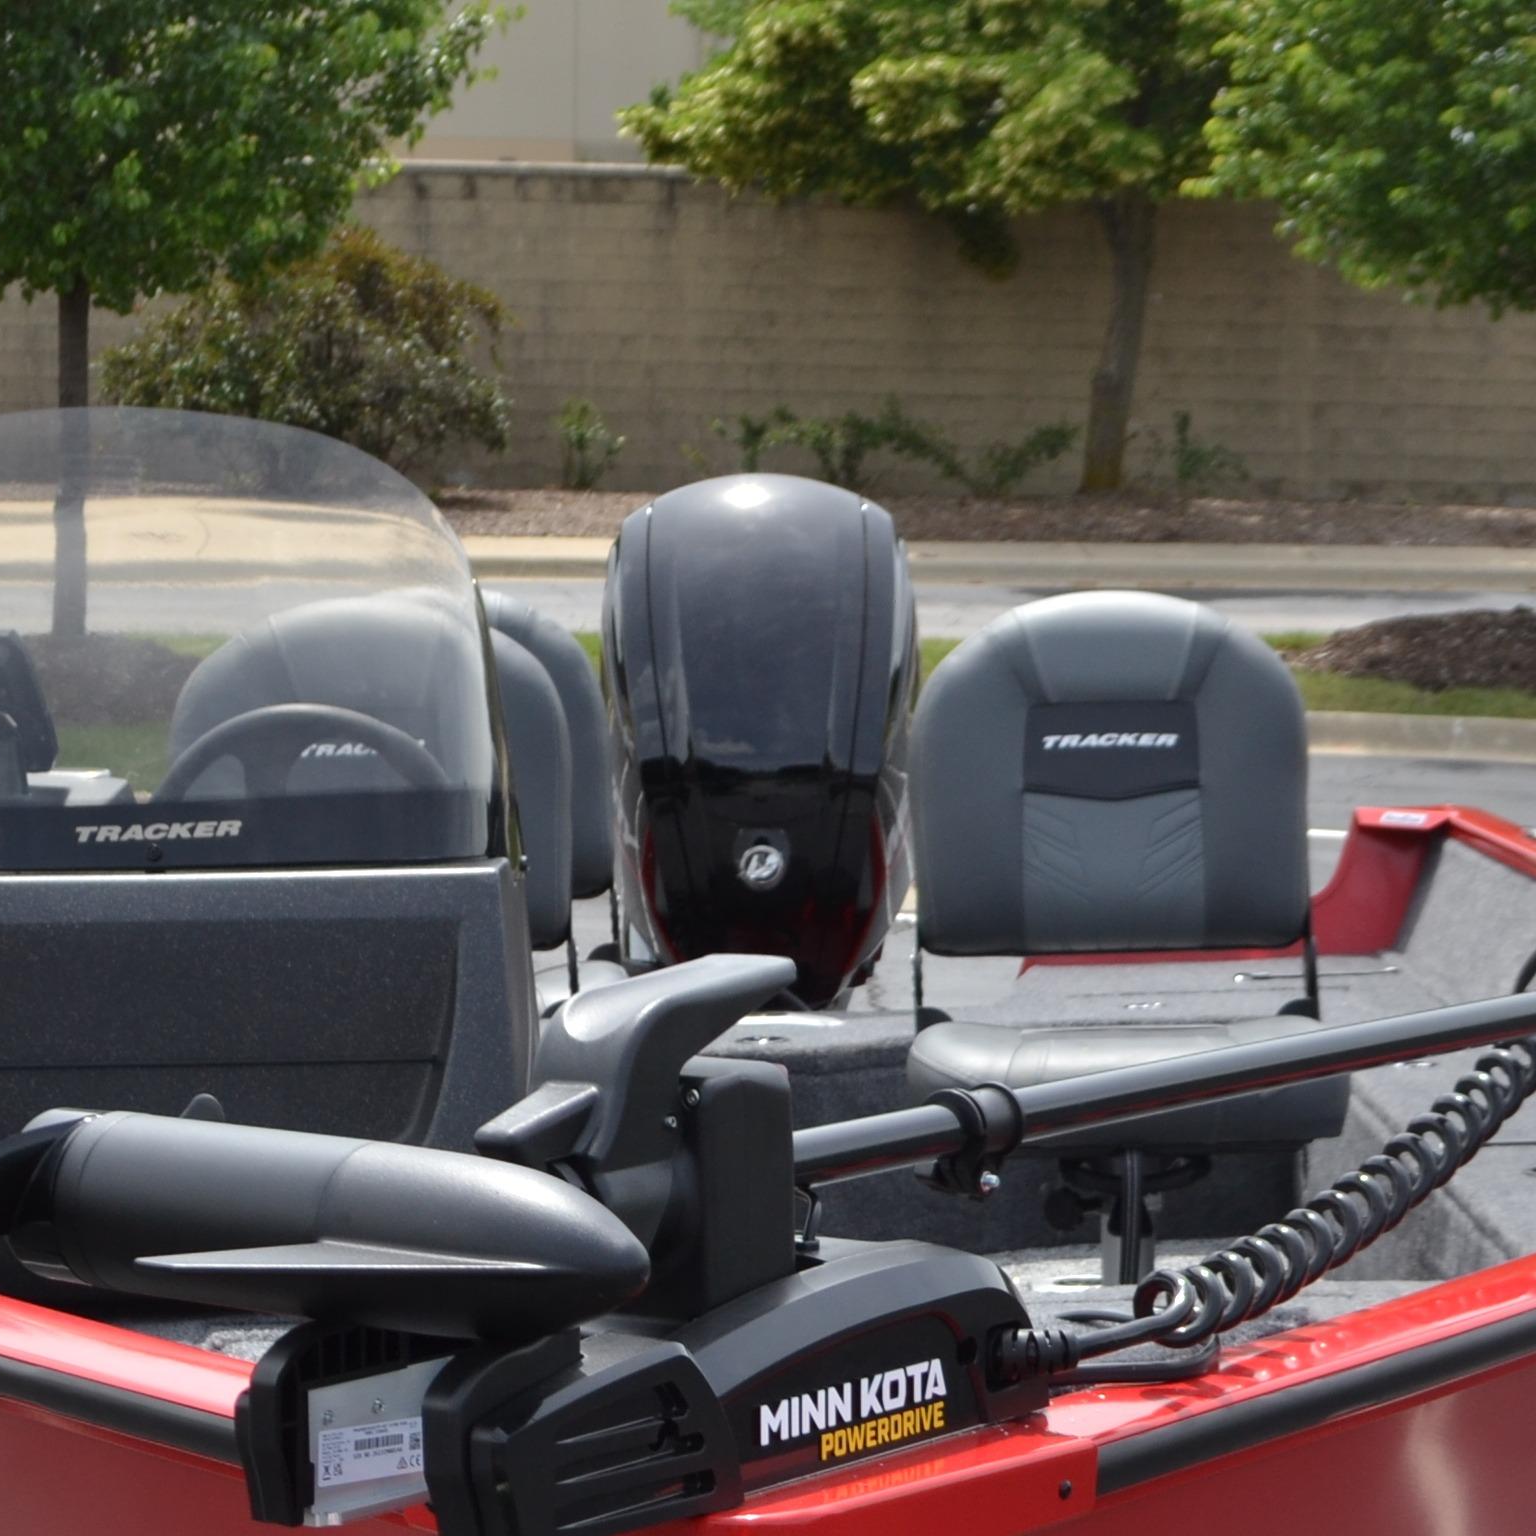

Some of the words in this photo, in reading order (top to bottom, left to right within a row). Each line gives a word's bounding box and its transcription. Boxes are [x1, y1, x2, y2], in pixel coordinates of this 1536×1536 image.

[1042, 732, 1179, 750] TRACKER
[75, 820, 242, 843] TRACKER
[760, 1382, 852, 1446] MINN
[860, 1358, 947, 1418] KOTA
[821, 1401, 945, 1461] POWERDRIVE
